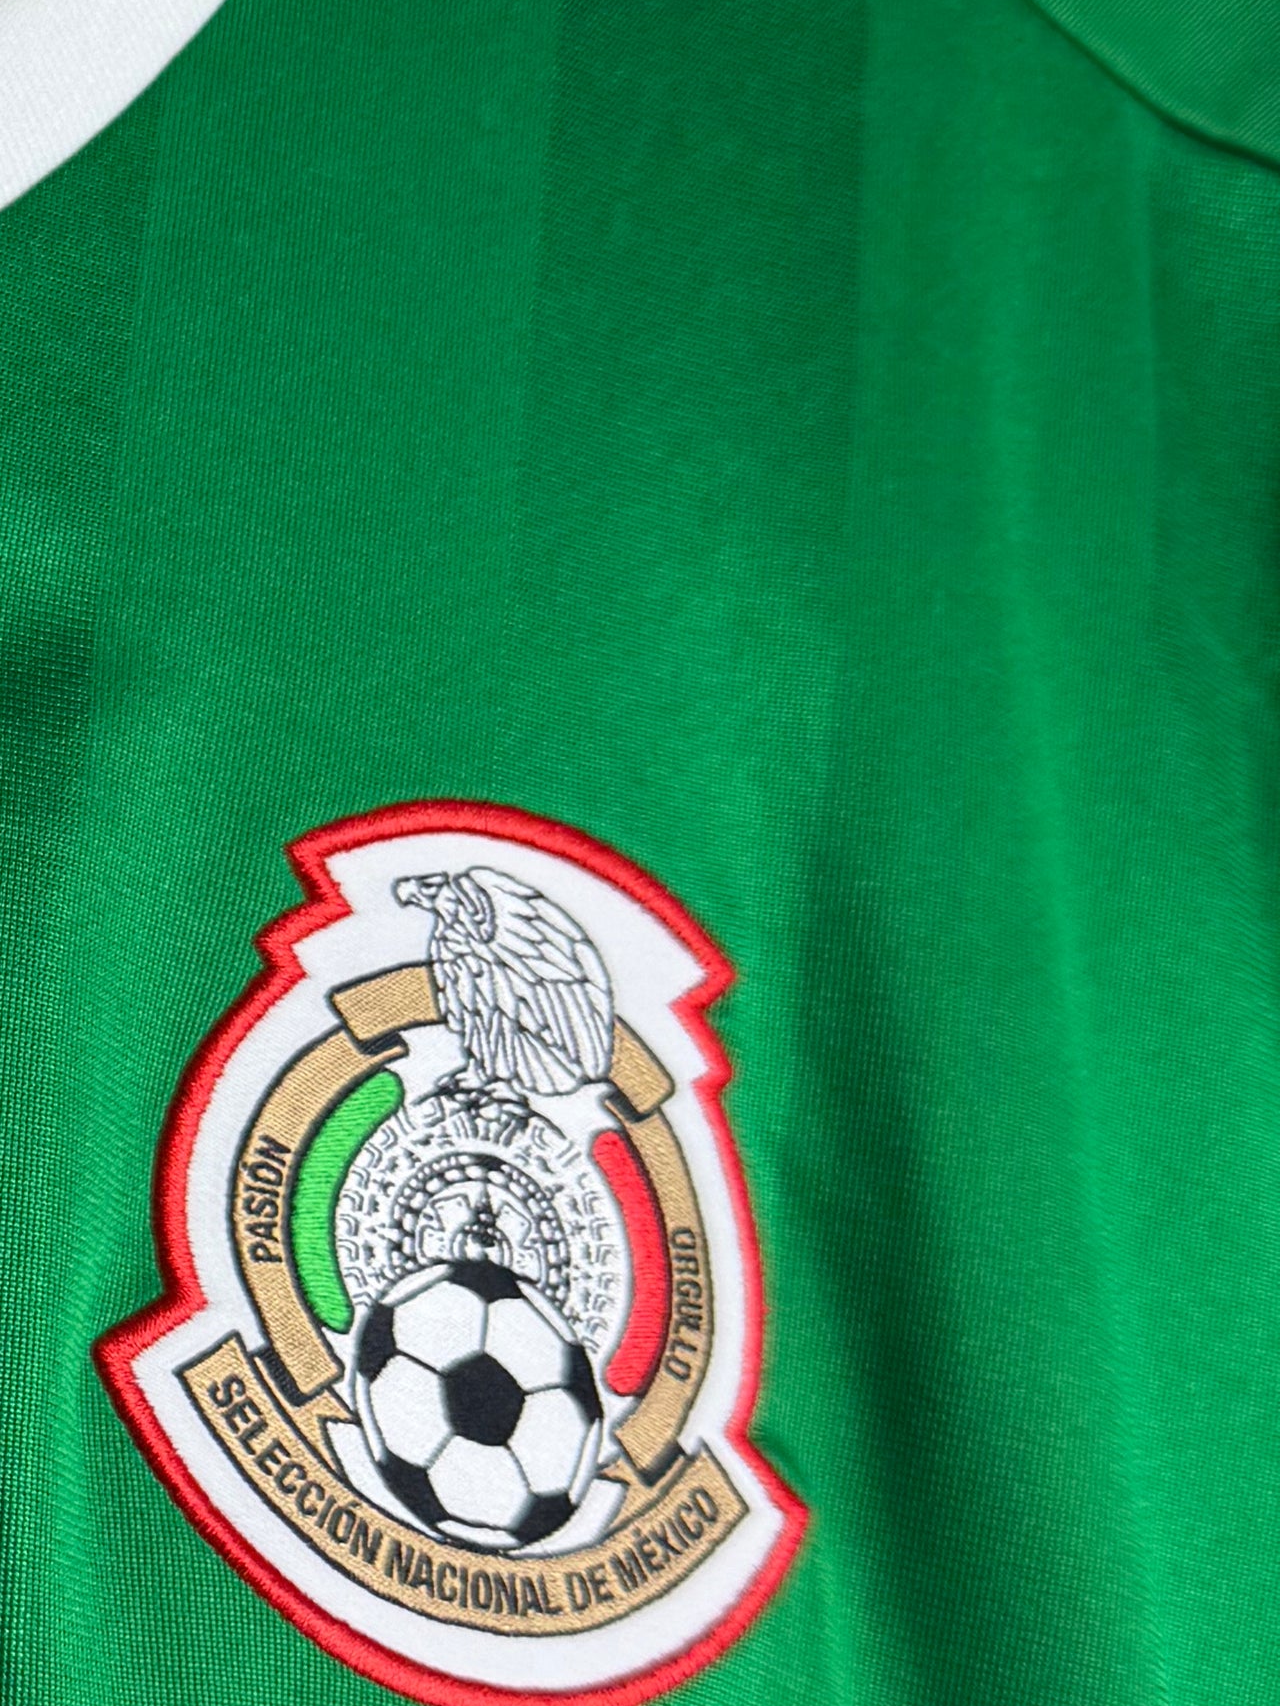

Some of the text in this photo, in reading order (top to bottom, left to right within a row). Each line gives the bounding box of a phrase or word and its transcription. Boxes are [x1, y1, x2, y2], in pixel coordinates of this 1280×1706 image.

[242, 1135, 291, 1262] PASIÓN
[663, 1227, 703, 1382] ORGULLO
[208, 1374, 719, 1616] SELECCIÓN NACIONAL DE MÉXICO
